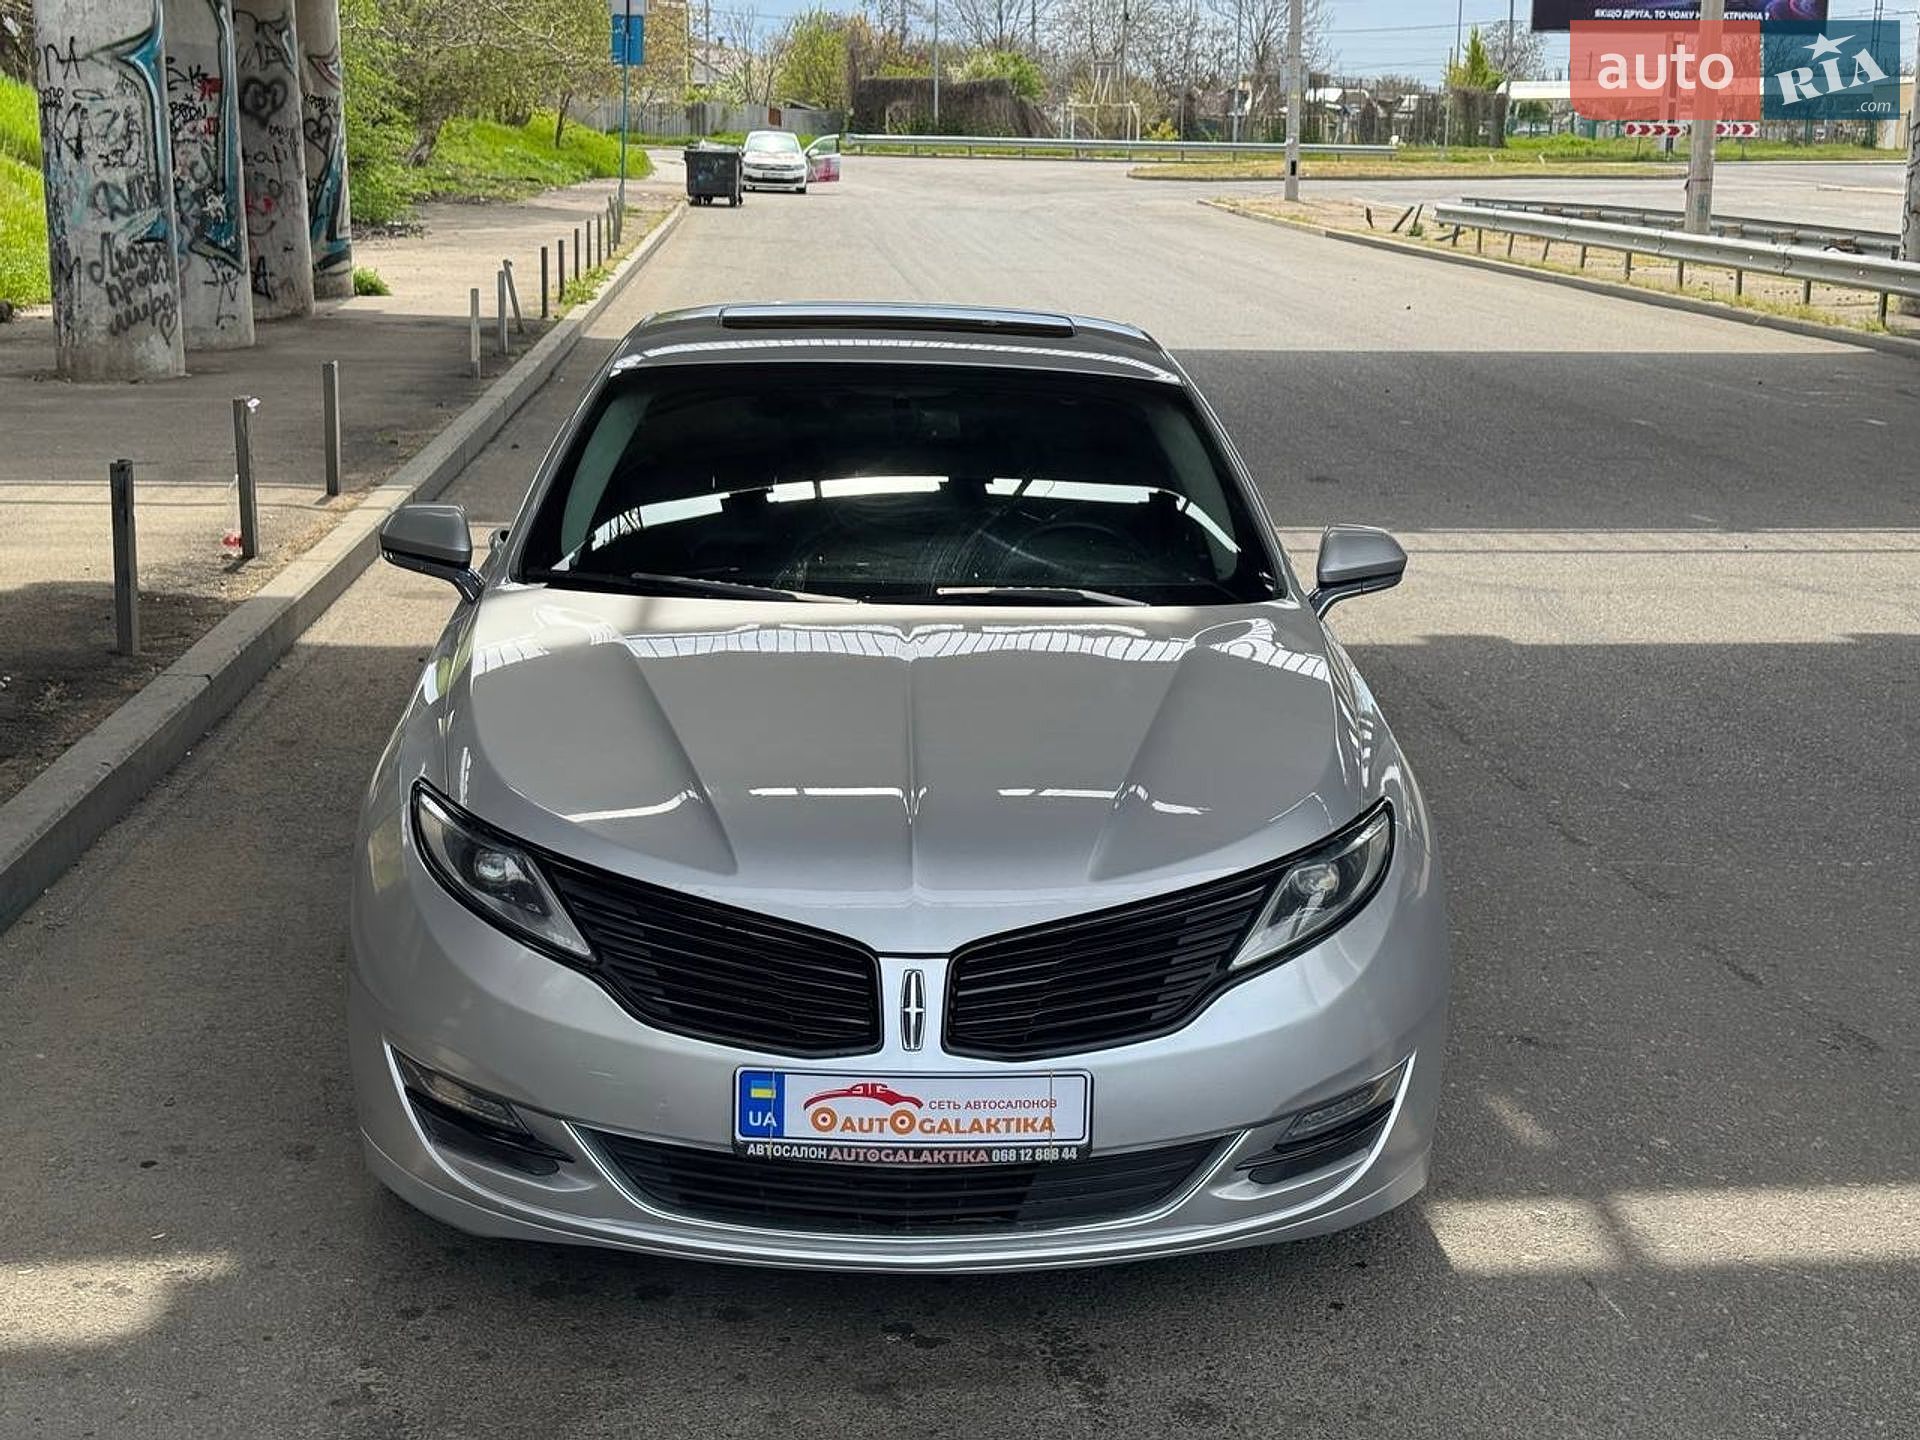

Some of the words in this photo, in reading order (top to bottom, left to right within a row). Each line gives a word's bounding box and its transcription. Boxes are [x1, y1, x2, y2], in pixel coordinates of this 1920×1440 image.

[1654, 11, 1666, 19] ТО
[1667, 11, 1695, 19] ЧОМУ
[1723, 12, 1763, 20] КТРИЧНА
[929, 1100, 961, 1110] СЕТЬ
[965, 1098, 1057, 1110] АВТОСАЛОНОВ
[749, 1110, 777, 1127] UA
[747, 1143, 827, 1159] АВТОСАЛОН
[829, 1147, 989, 1164] AUTOGALAKTIKA
[992, 1149, 1017, 1162] 068
[1019, 1148, 1032, 1161] 12
